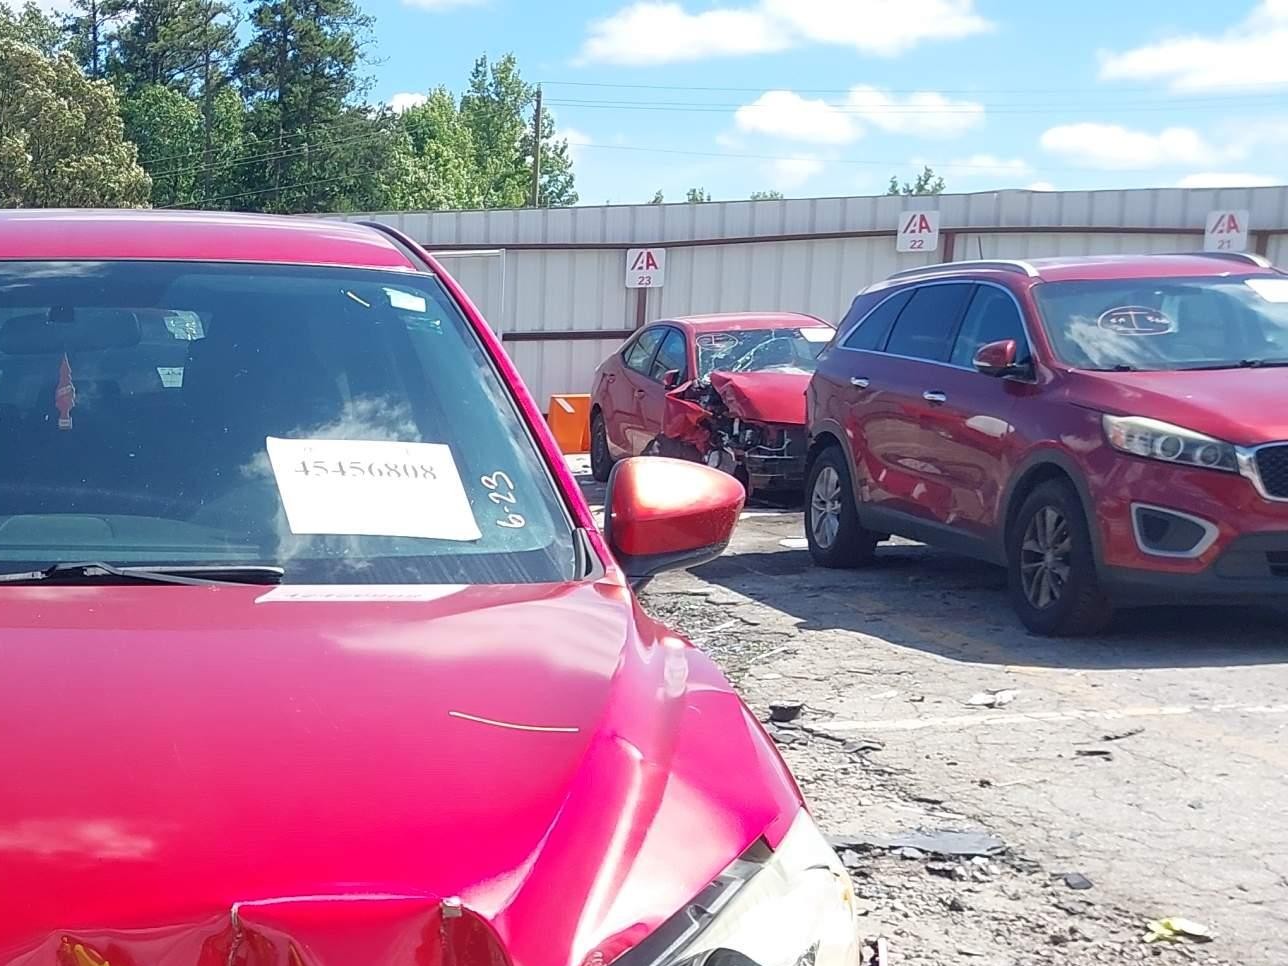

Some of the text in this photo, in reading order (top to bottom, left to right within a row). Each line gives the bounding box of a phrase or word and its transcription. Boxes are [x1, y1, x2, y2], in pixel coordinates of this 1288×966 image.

[910, 239, 924, 249] 22
[638, 275, 652, 286] 23
[294, 460, 438, 481] 45456808
